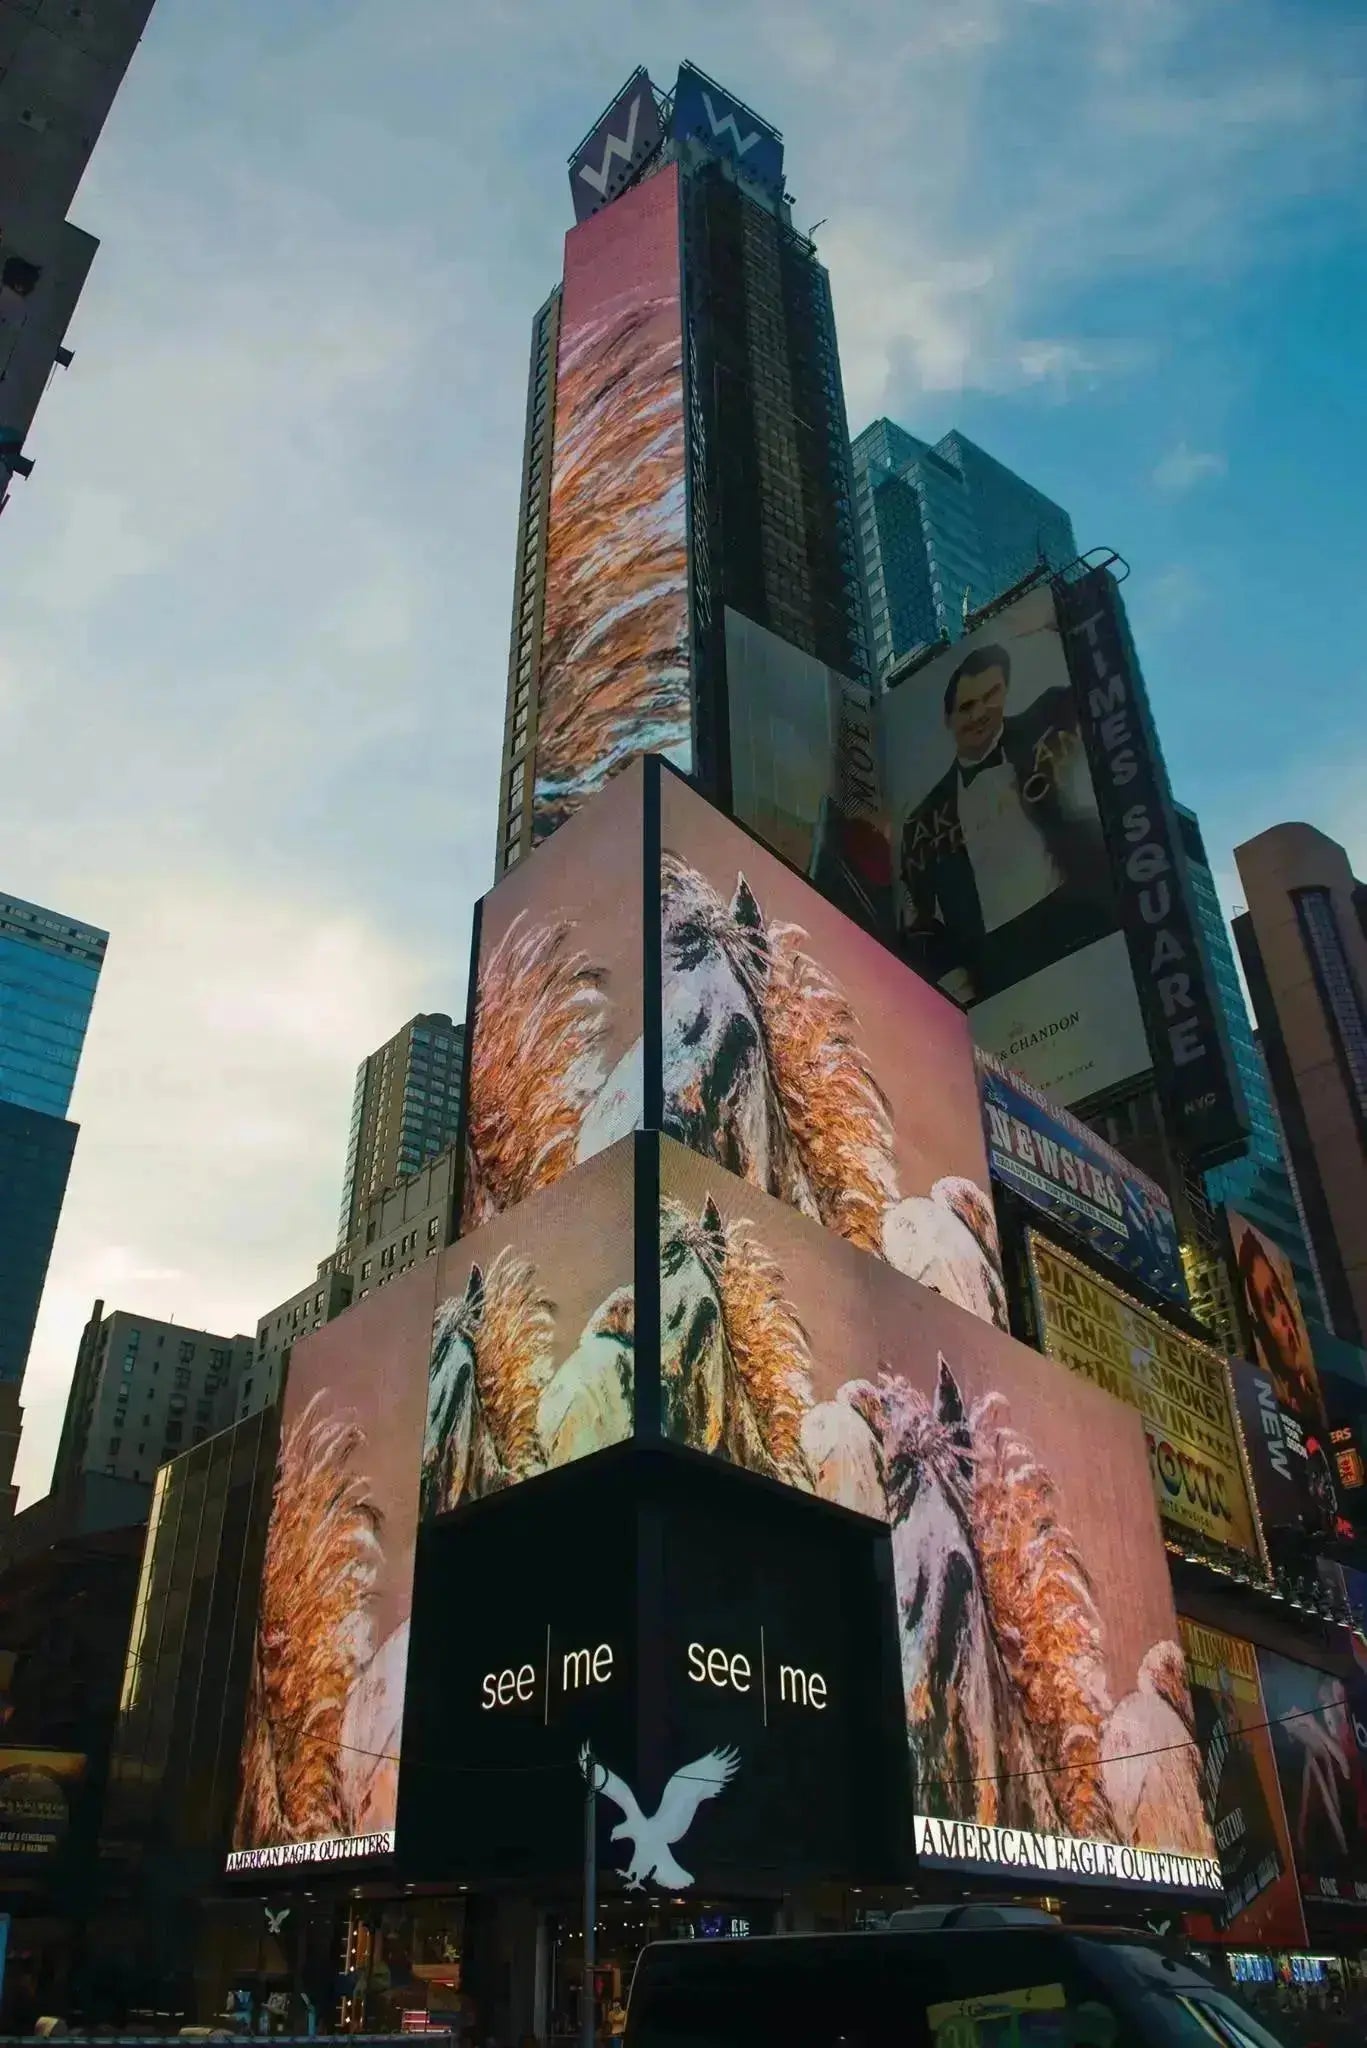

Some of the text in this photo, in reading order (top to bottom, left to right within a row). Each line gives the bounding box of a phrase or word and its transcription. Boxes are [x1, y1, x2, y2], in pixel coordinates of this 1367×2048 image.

[578, 94, 641, 197] W
[701, 90, 762, 157] W
[1076, 609, 1208, 1069] TIMES SQUARE
[1009, 1010, 1080, 1056] CHANDON
[984, 1101, 1124, 1217] NEWSIES
[1037, 1252, 1223, 1393] DIANA STEVIE
[1150, 1361, 1225, 1427] SMOKEY
[1254, 1377, 1293, 1481] NEW
[481, 1643, 614, 1710] see me
[688, 1642, 828, 1710] see me
[227, 1832, 391, 1872] AMERICAN EAGLE OUTFITTERS
[921, 1818, 1049, 1871] AMERICAN
[1054, 1835, 1117, 1876] EAGLE
[1121, 1847, 1224, 1889] OUTFITTERS
